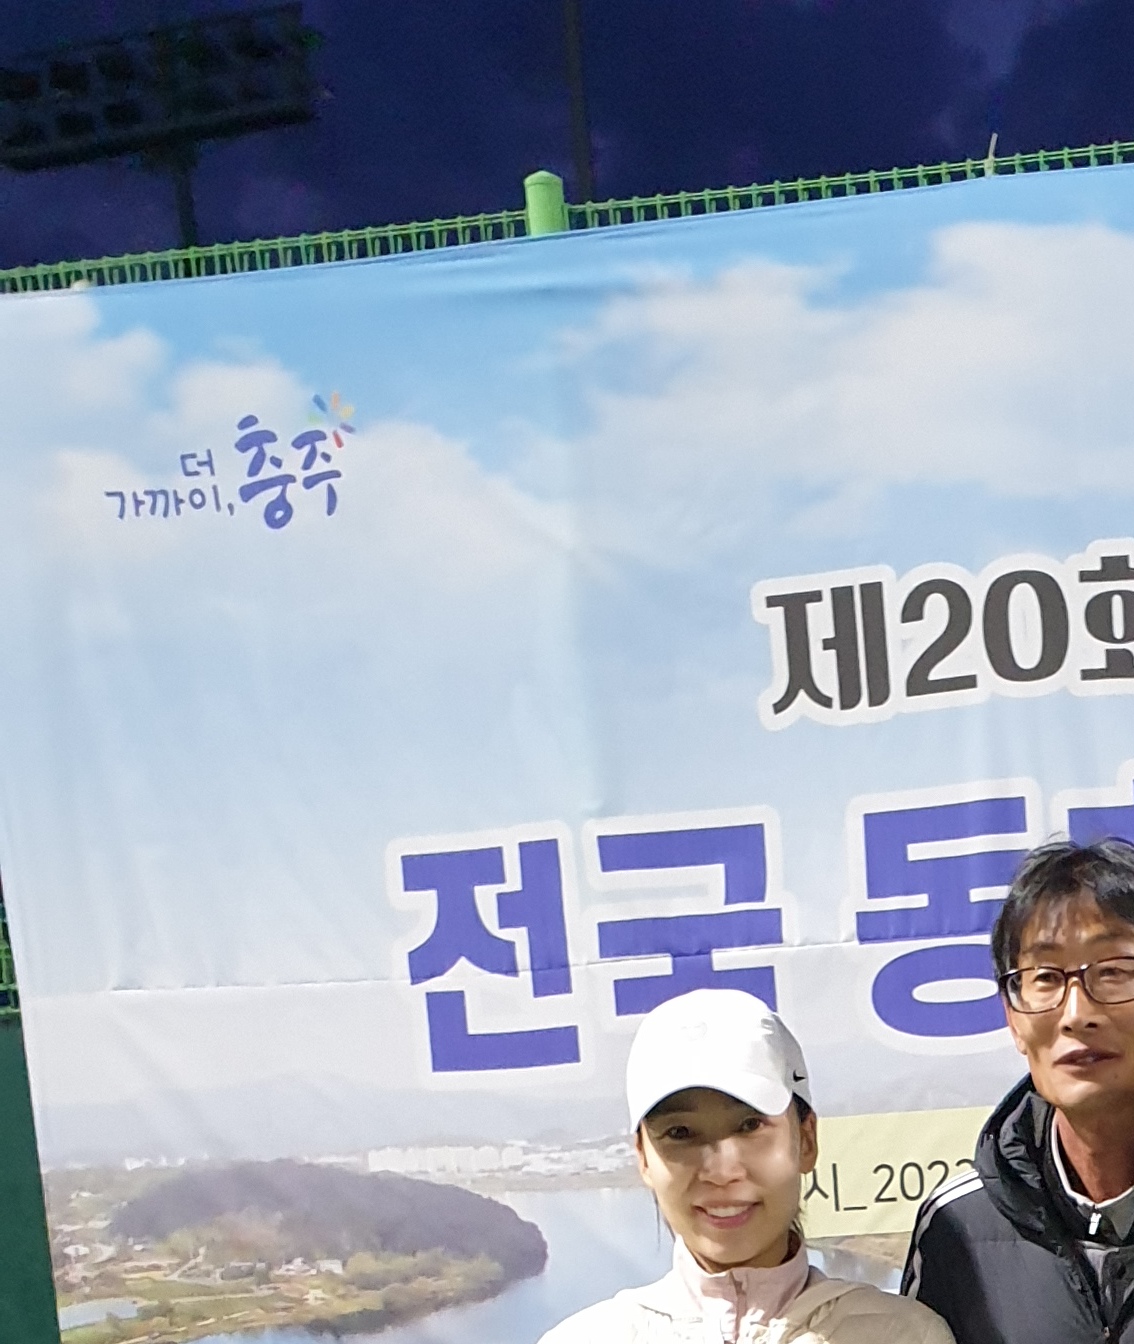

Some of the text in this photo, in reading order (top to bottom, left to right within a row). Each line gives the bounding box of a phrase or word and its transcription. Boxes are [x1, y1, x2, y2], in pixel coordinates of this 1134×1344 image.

[105, 414, 342, 529] 가까이, 충주
[180, 449, 216, 477] 더
[400, 821, 783, 1072] 전국
